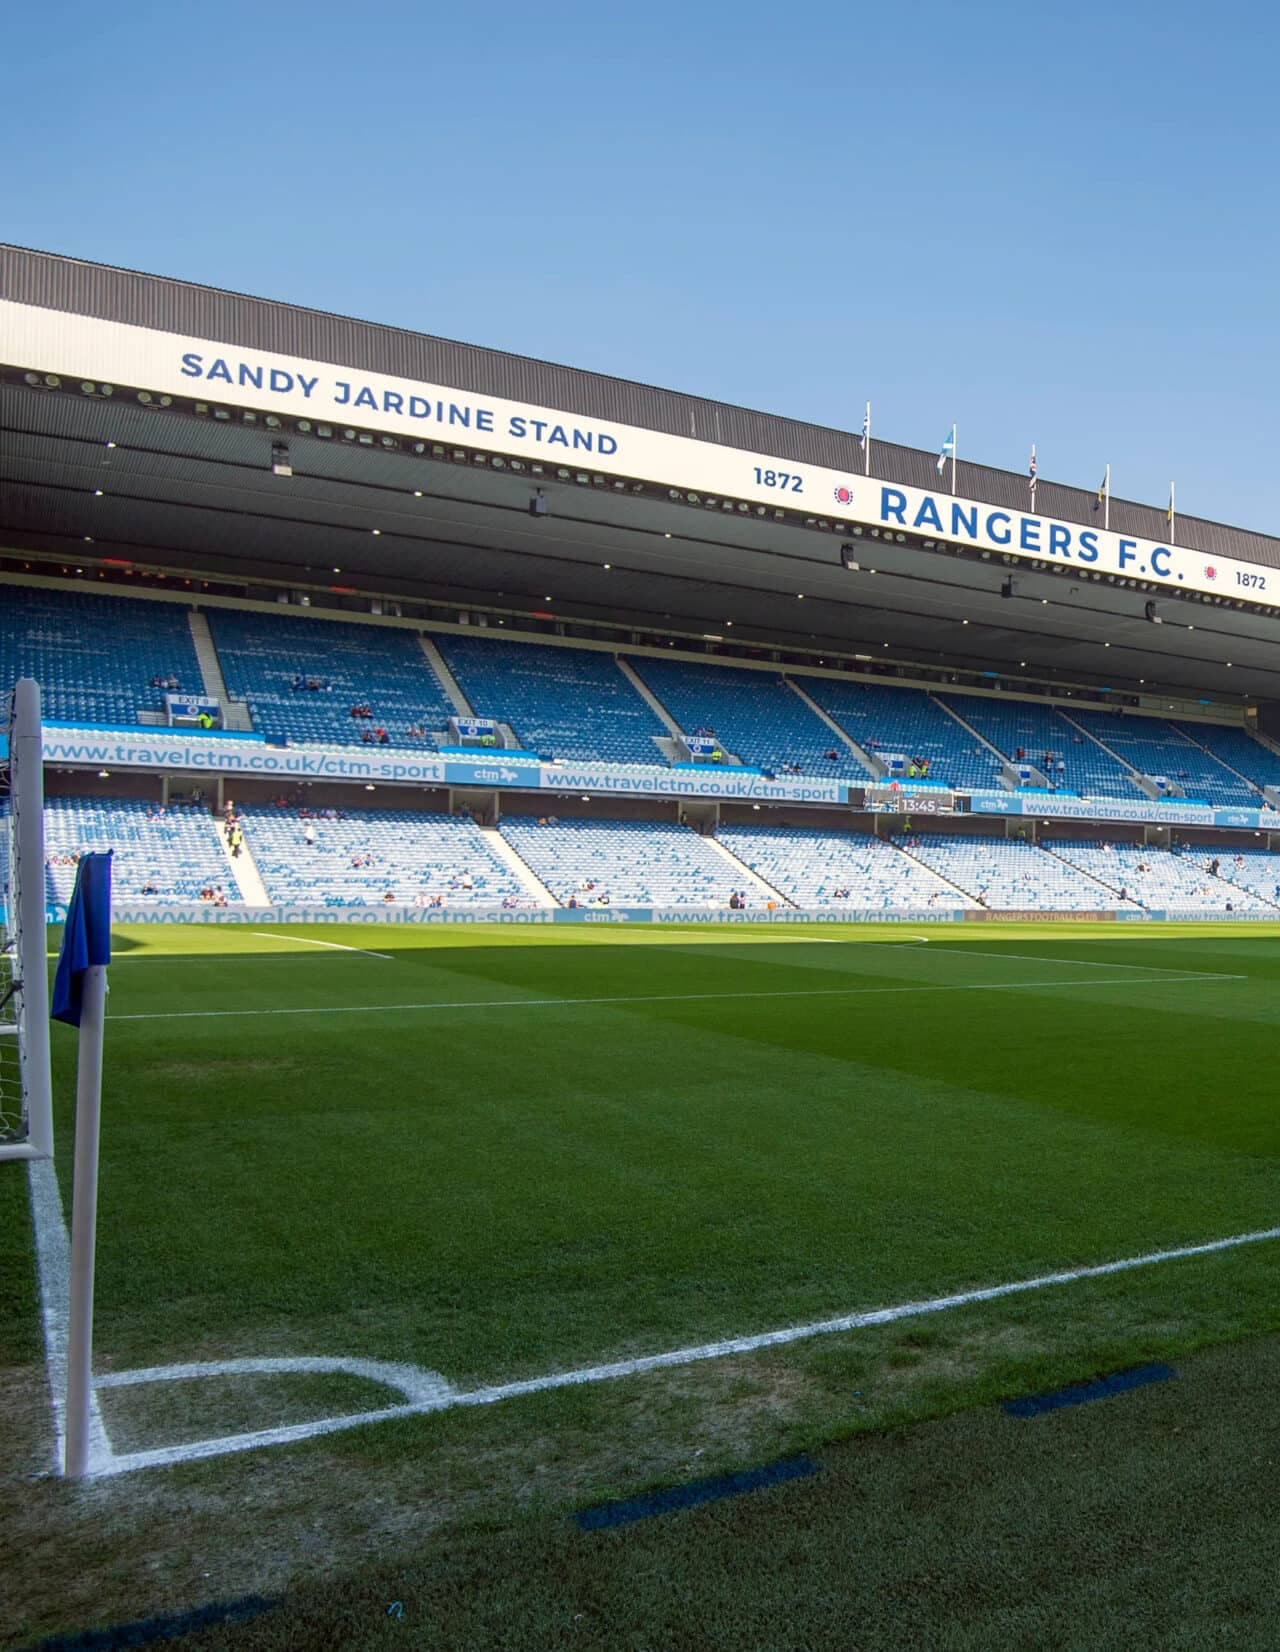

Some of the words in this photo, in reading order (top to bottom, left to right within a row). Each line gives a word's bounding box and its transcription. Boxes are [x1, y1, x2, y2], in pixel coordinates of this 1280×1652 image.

[181, 353, 319, 398] SANDY
[334, 382, 494, 432] JARDINE
[508, 416, 618, 455] STAND
[753, 467, 804, 493] 1872
[881, 487, 1099, 562] RANGERS
[1118, 538, 1184, 580] F.C.
[1236, 571, 1266, 590] 1872
[547, 773, 836, 801] www.travelctm.co.uk/ctm-sport
[902, 799, 935, 812] 13:45
[1026, 803, 1213, 823] www.travelctm.co.uk/ctm-sport
[114, 908, 548, 922] wwwtravelctmcouk/ctm-sport
[658, 909, 949, 921] wwwtravelctmcouk/ctm-sport
